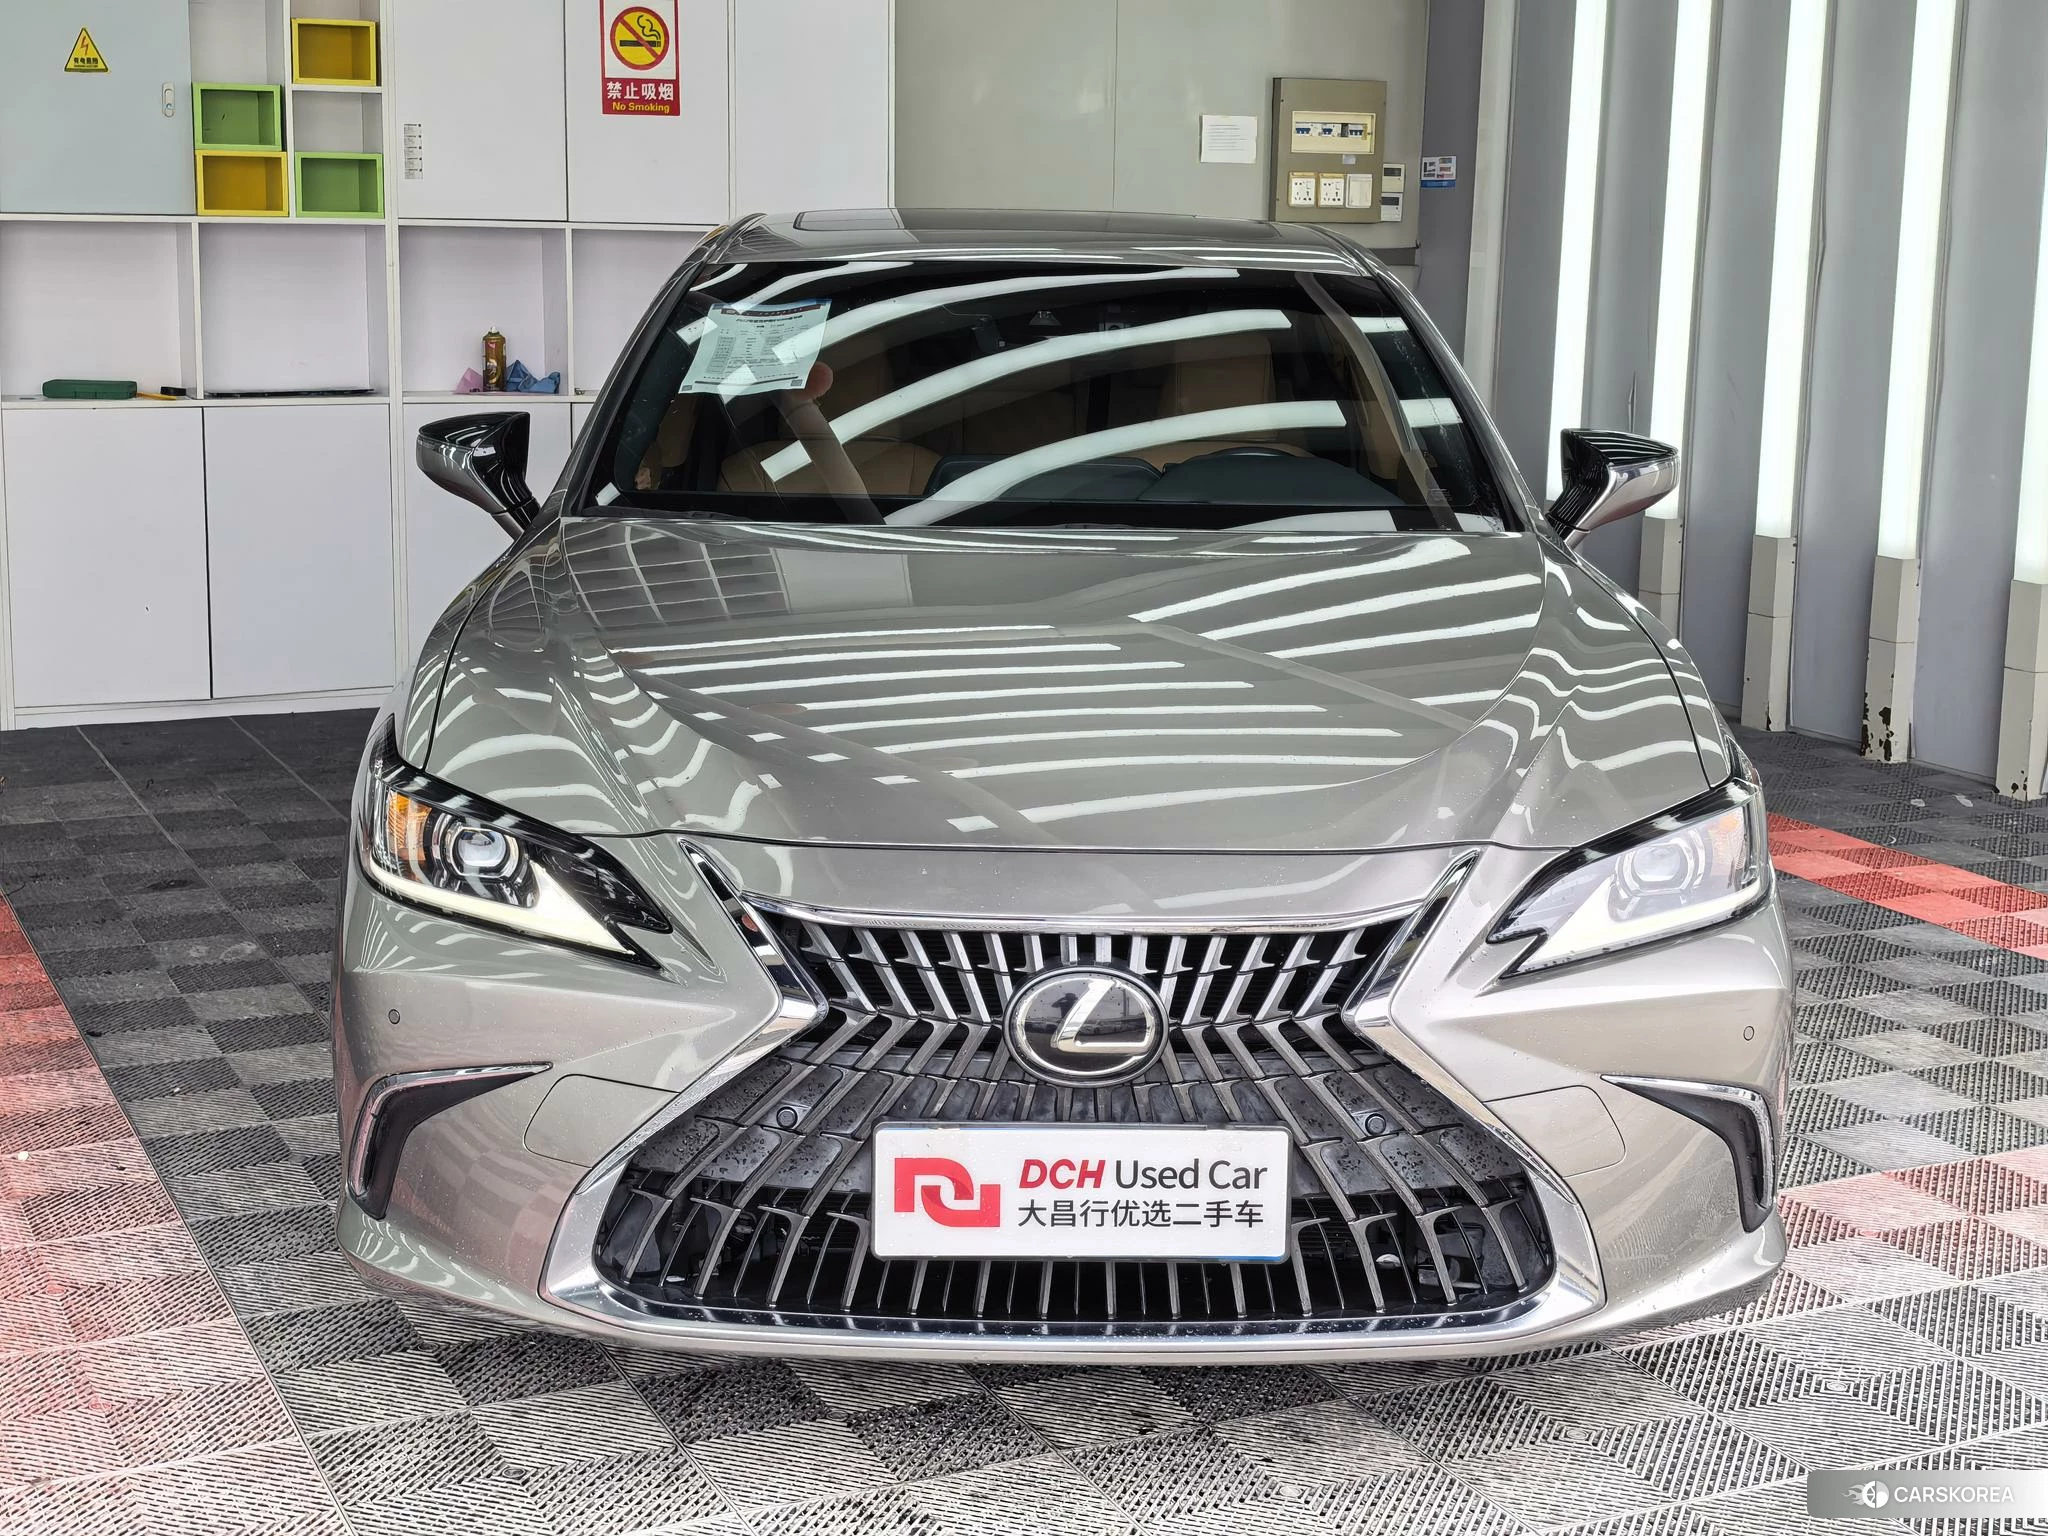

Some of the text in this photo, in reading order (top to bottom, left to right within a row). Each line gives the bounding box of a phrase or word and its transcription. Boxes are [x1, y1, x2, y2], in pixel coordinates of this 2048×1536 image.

[606, 81, 674, 101] 禁止吸烟
[612, 101, 670, 114] No Smoking
[1018, 1158, 1268, 1189] DCH Used Car
[1017, 1199, 1265, 1228] 大昌行优选二手车
